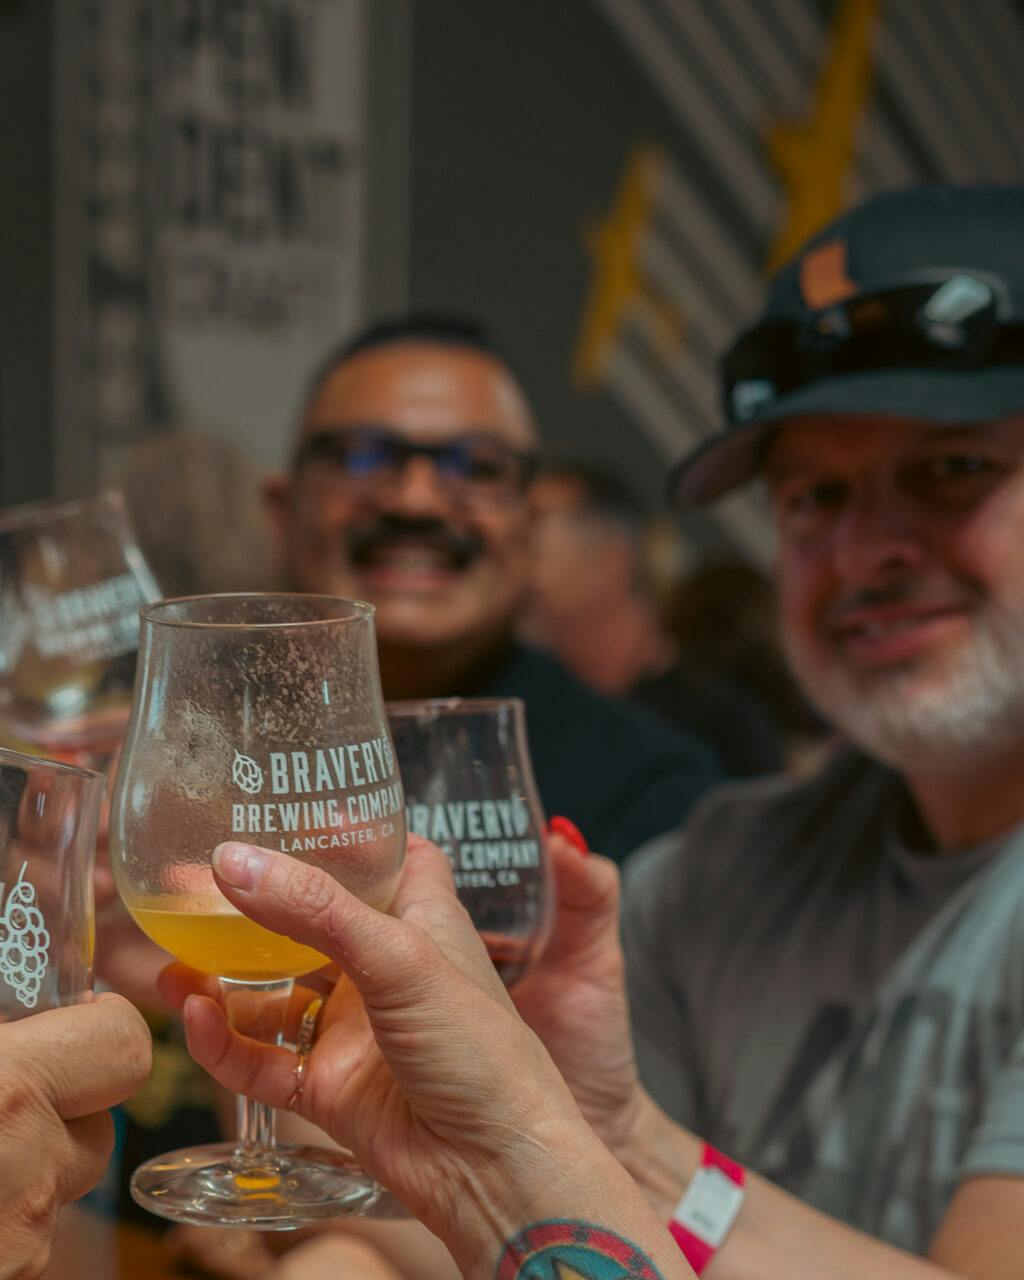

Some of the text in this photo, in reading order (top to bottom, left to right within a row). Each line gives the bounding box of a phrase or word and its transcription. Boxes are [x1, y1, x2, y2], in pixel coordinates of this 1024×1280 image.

[269, 738, 389, 795] BRAVERY
[232, 799, 342, 833] BREWING
[381, 823, 396, 838] CA
